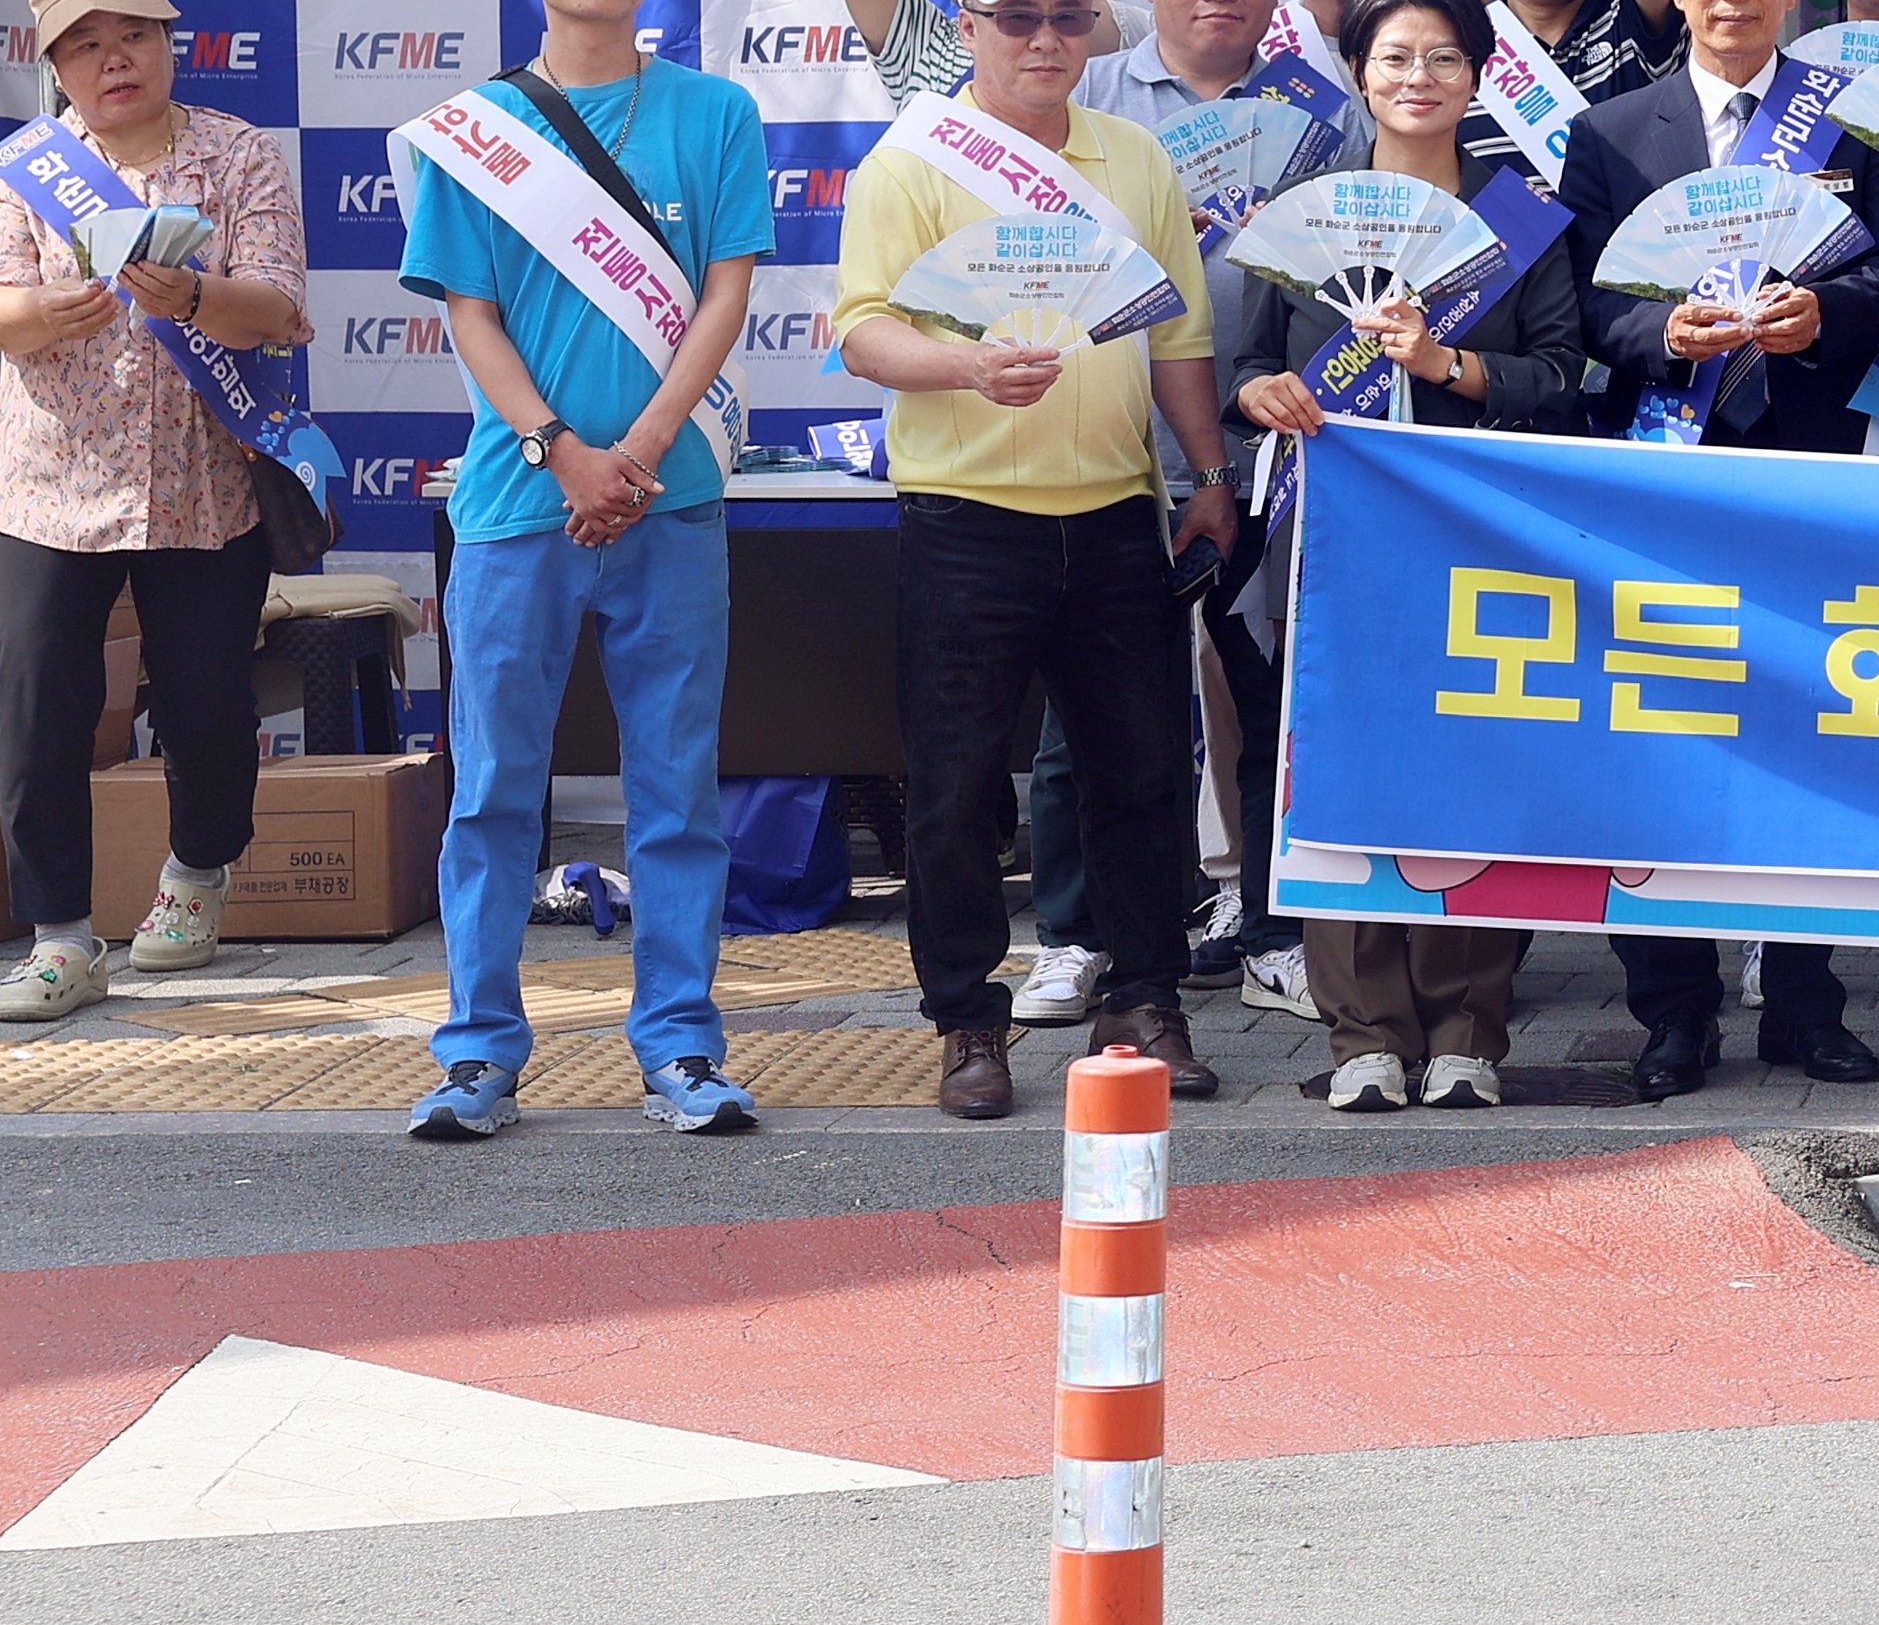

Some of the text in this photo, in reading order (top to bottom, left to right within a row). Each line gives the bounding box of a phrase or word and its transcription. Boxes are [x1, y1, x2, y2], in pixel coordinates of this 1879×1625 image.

[172, 33, 260, 70] FME
[335, 32, 465, 70] KFME
[741, 27, 867, 64] KFME
[1334, 183, 1410, 201] 함께합시다
[1684, 176, 1760, 200] 함께합시다
[1333, 200, 1410, 218] 같이삽시다
[1687, 192, 1764, 217] 같이삽시다
[996, 226, 1077, 242] 함께합시다
[996, 243, 1077, 258] 같이삽시다
[968, 263, 1110, 273] 모든 화순군 소상공인을 응원합니다
[1435, 568, 1747, 738] 모든
[290, 852, 345, 866] 500 EA
[294, 877, 349, 894] 부채공장
